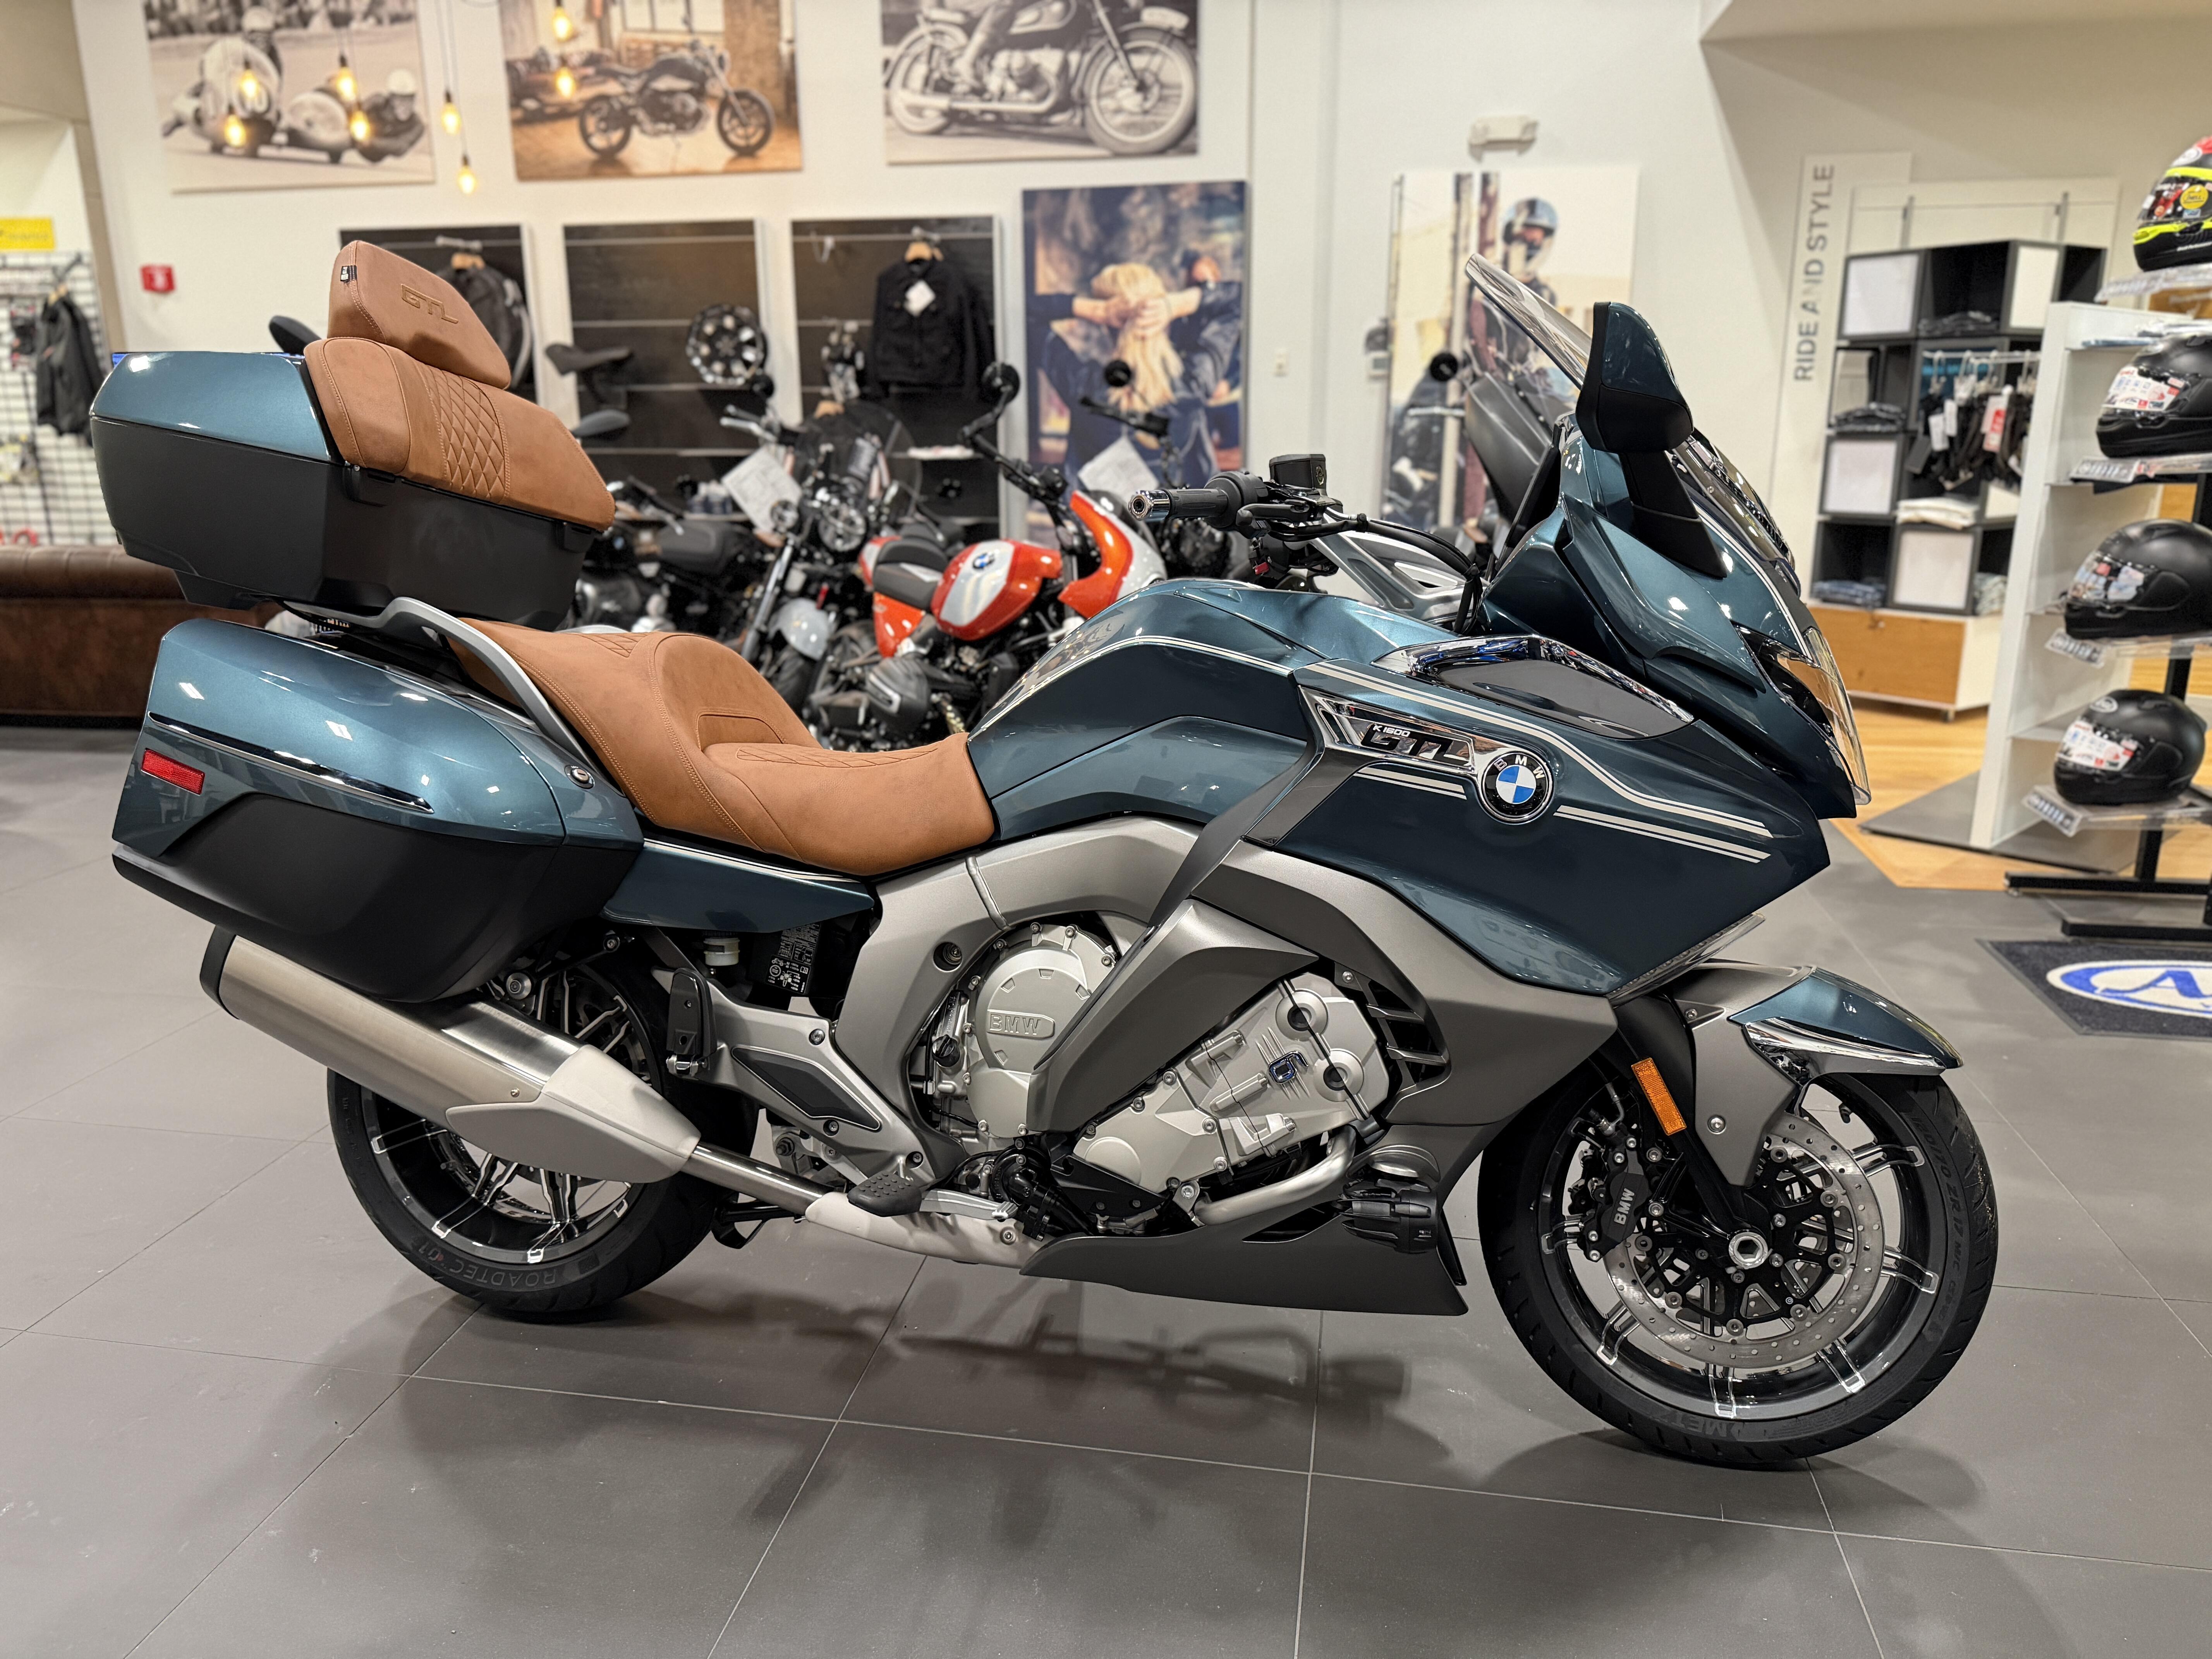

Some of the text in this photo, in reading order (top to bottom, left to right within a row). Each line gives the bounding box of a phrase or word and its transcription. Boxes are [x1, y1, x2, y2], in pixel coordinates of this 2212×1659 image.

[1806, 164, 1834, 252] STYLE
[400, 283, 459, 324] GTL
[1794, 322, 1819, 382] RIDE
[1360, 723, 1470, 766] GTL
[1382, 726, 1411, 737] 1600
[1493, 754, 1545, 779] BMW
[989, 1013, 1041, 1035] BMW
[1614, 1188, 1635, 1225] BMW
